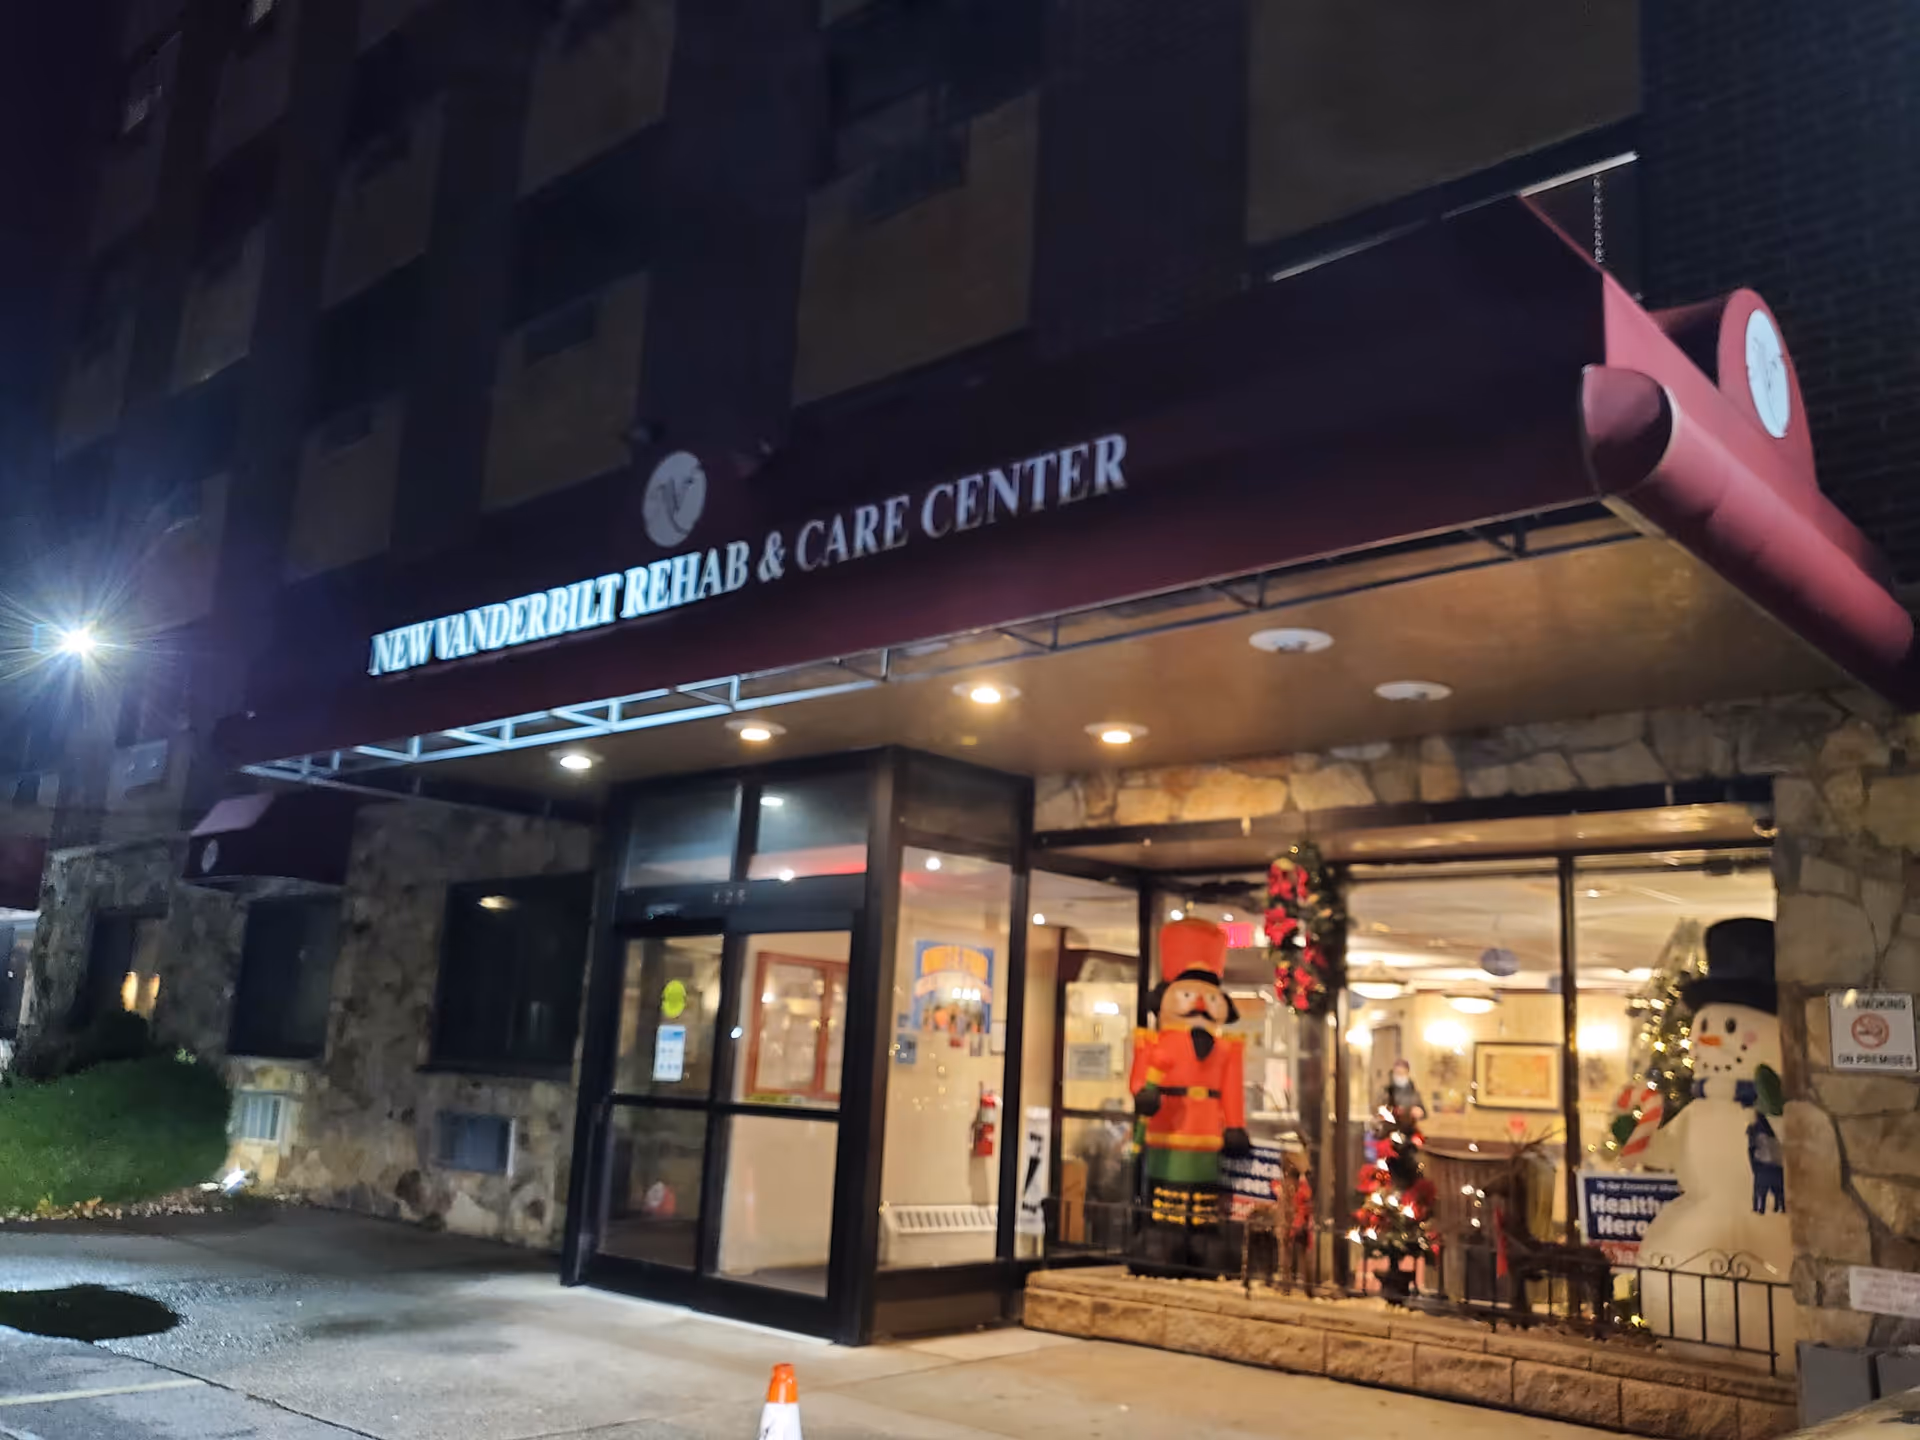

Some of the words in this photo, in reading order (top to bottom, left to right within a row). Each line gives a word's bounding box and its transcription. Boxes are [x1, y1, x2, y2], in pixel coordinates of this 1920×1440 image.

[366, 618, 436, 676] NEW
[434, 572, 622, 661] VANDERBILT
[619, 540, 751, 620] REHAB
[756, 530, 786, 583] &
[795, 494, 910, 572] CARE
[920, 432, 1128, 539] CENTER
[1589, 1193, 1664, 1217] Health
[1597, 1214, 1649, 1237] Hero
